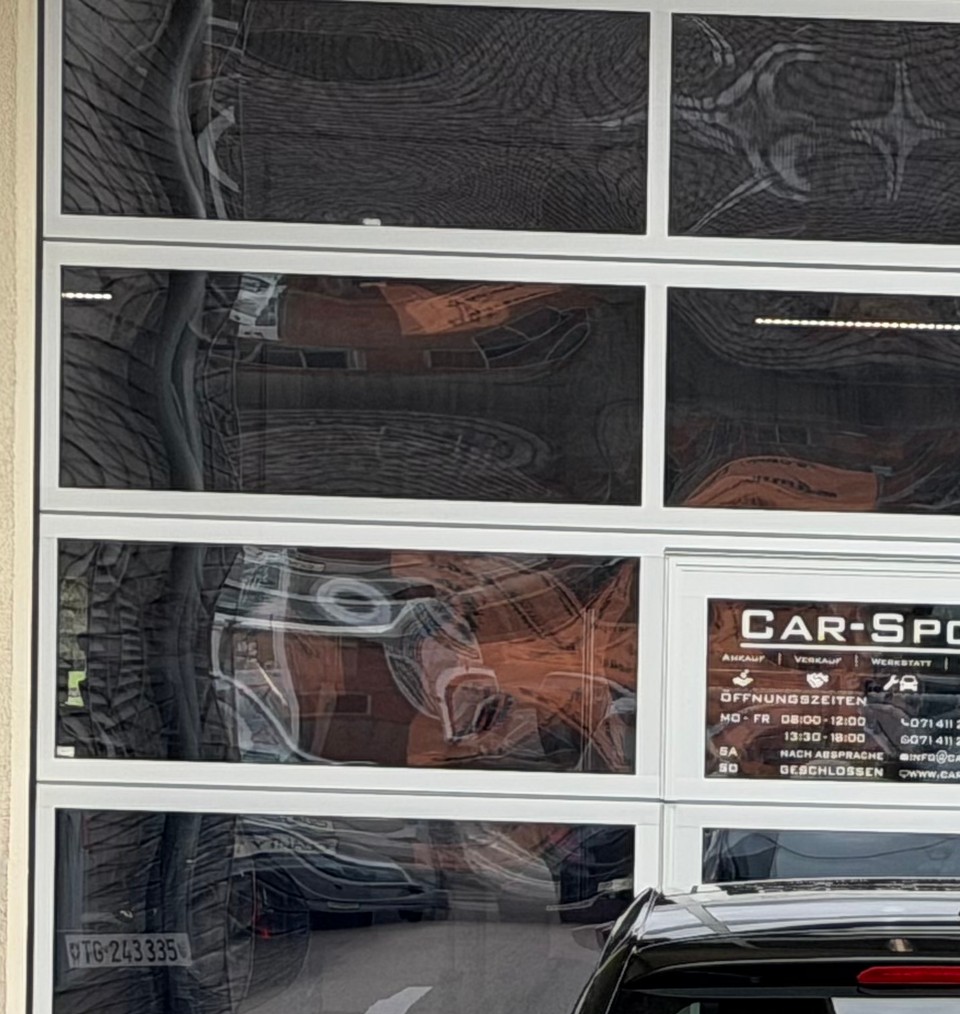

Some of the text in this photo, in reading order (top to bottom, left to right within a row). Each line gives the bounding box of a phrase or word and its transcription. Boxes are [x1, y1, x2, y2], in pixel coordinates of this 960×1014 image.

[794, 655, 842, 665] VERKAUF
[871, 658, 932, 668] WERKSTATT
[720, 689, 867, 705] ÖFFNUNGSZEITEN
[720, 713, 741, 723] MO
[753, 714, 770, 724] FR
[910, 718, 933, 728] 071
[910, 735, 933, 745] 071
[719, 746, 739, 757] SA
[780, 750, 884, 760] NACH ABSPRACHE
[719, 763, 738, 773] SO
[780, 765, 884, 777] GESCHLOSSEN
